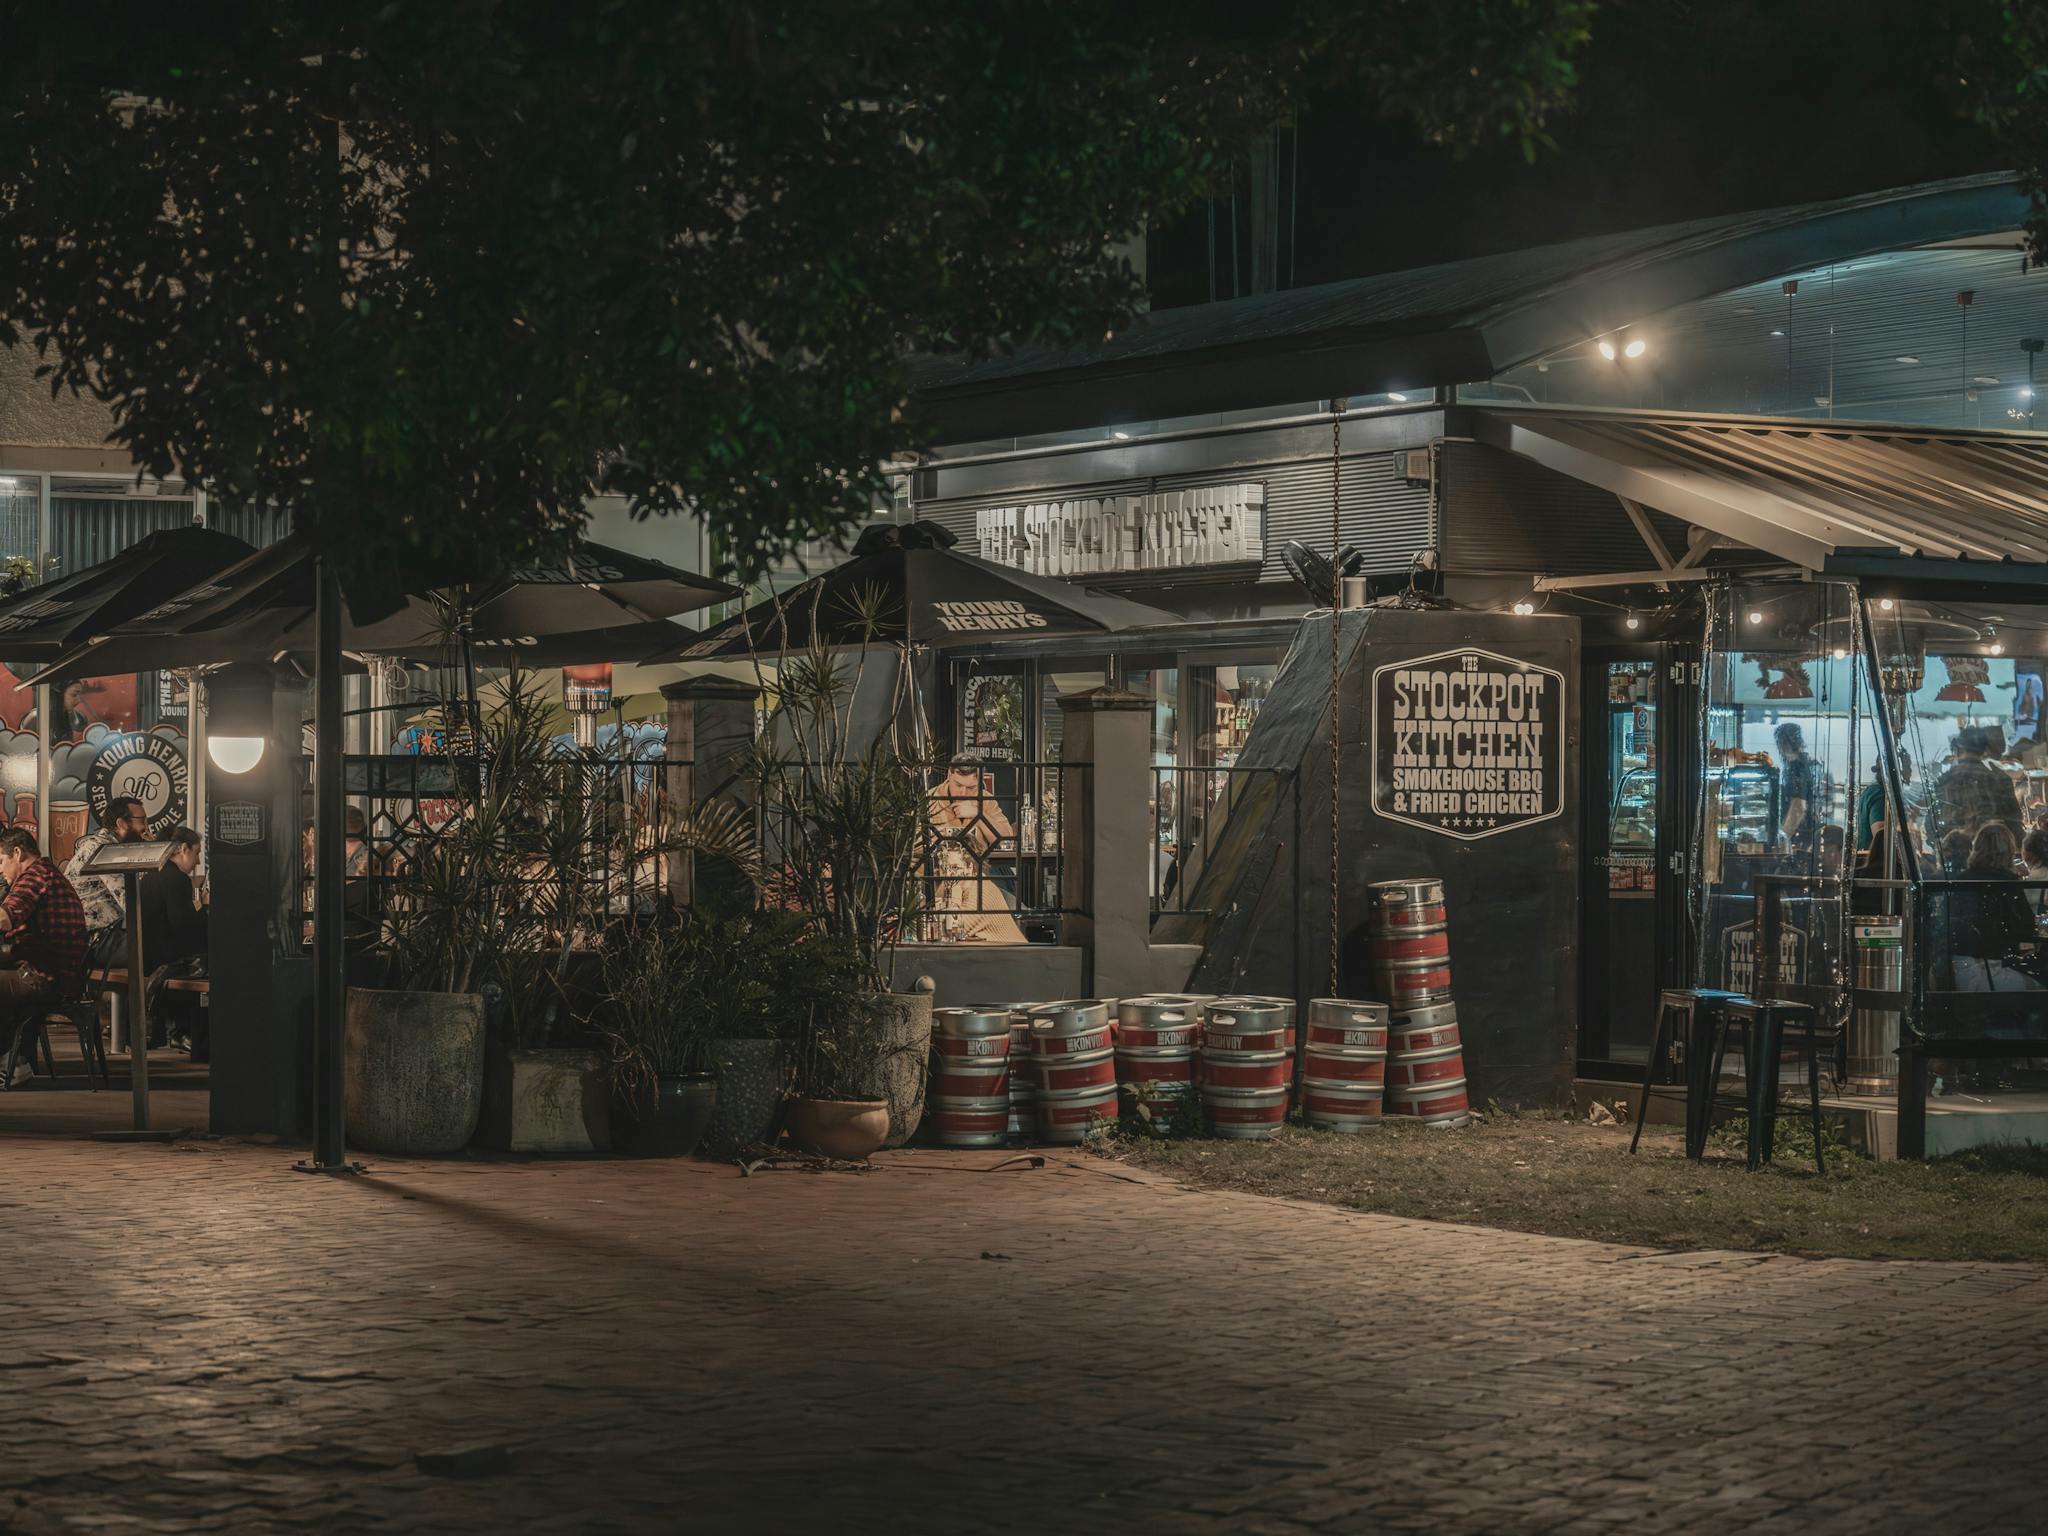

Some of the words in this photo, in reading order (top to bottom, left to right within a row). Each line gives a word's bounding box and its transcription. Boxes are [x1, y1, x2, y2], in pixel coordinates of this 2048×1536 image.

[976, 507, 1018, 563] THE
[1141, 485, 1252, 567] KITCHEN
[930, 600, 1026, 616] YOUNG
[937, 613, 1048, 631] HENRYS
[1462, 656, 1478, 671] THE
[1393, 670, 1544, 722] STOCKPOT
[964, 719, 976, 746] THE
[1393, 720, 1543, 769] KITCHEN
[95, 736, 145, 772] YOUNG
[1393, 768, 1506, 791] SMOKEHOUSE
[1509, 769, 1543, 794] BBQ
[1393, 792, 1408, 812] &
[1410, 792, 1461, 814] FRIED
[1465, 793, 1543, 815] CHICKEN
[1072, 1034, 1104, 1051] KONVOY
